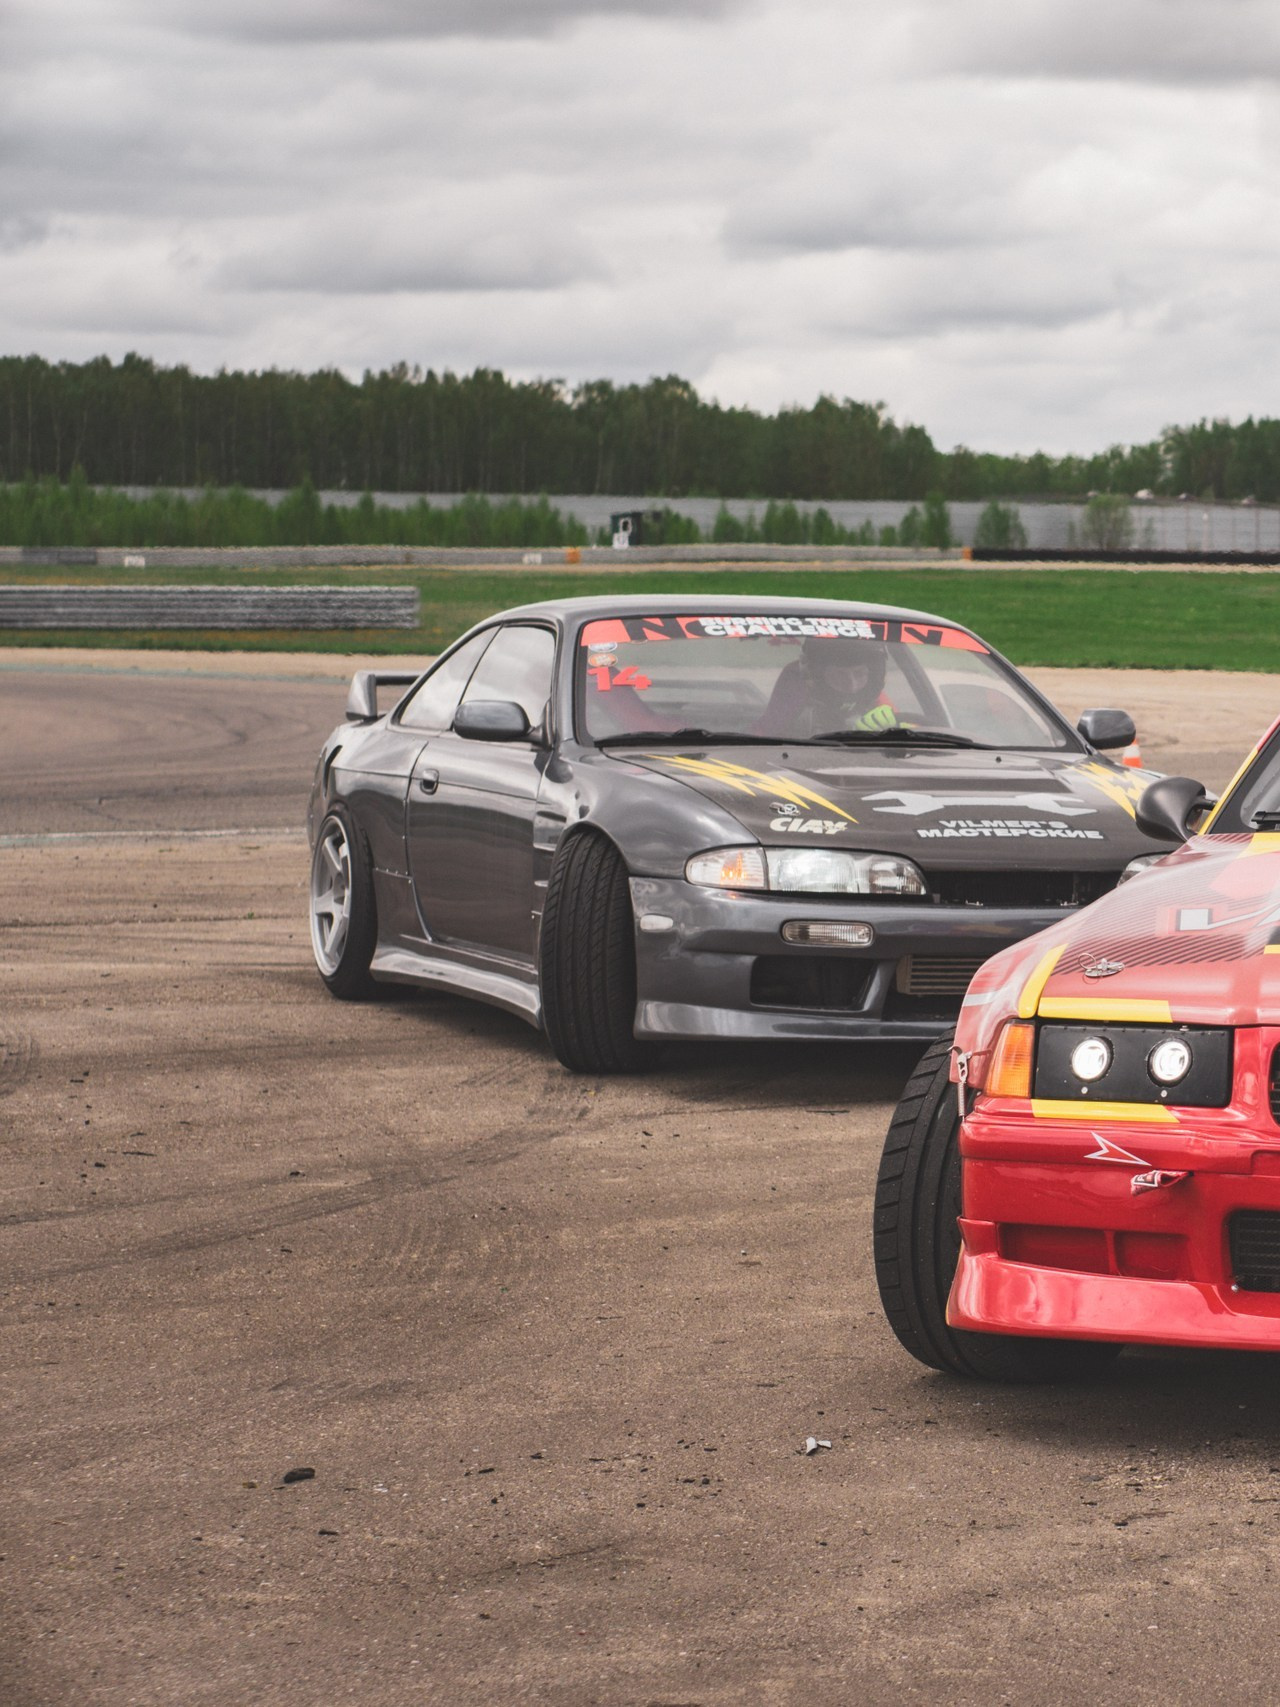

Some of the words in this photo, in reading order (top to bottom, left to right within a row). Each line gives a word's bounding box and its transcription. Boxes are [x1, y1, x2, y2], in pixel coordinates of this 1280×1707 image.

[698, 616, 802, 627] BURNING
[804, 617, 871, 628] TIRES
[703, 624, 876, 639] CHALLENGE
[587, 666, 652, 692] 14
[938, 819, 1069, 830] VILMER'S
[916, 828, 1105, 840] МАСТЕРСКИЕ
